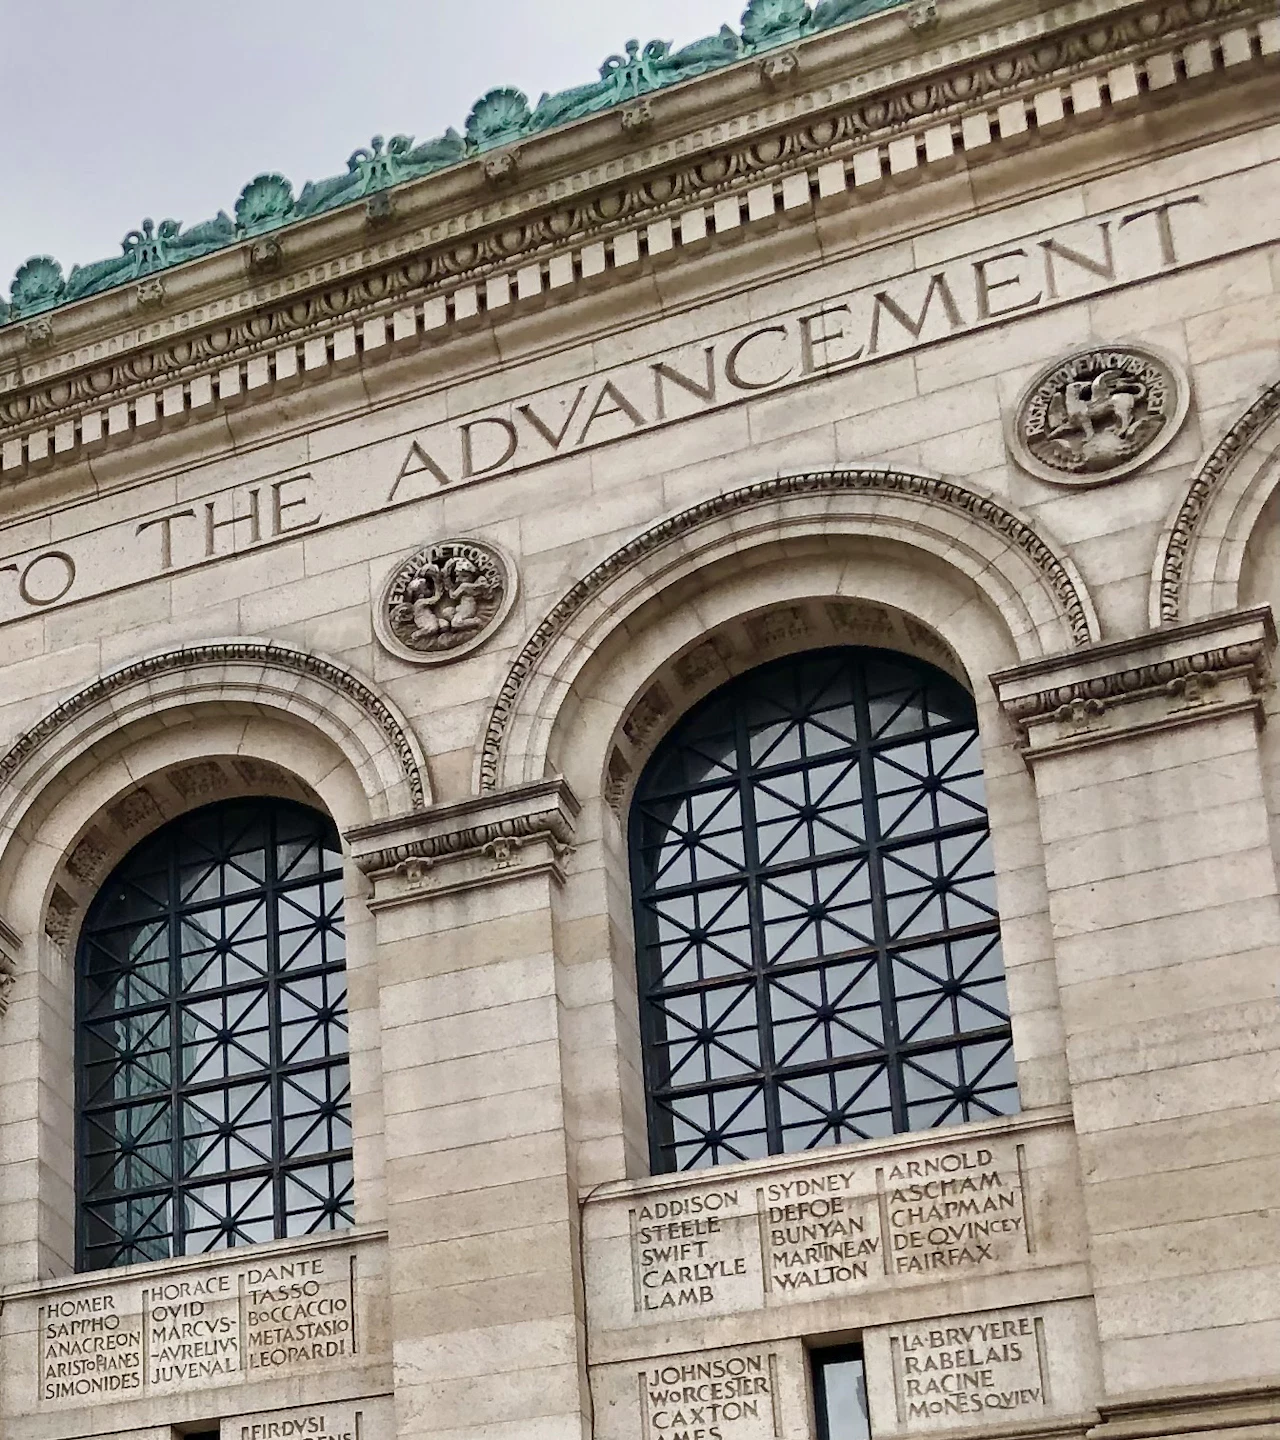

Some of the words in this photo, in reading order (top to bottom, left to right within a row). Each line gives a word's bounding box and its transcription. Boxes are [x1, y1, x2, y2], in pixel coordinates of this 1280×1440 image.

[136, 473, 324, 569] THE
[387, 195, 1207, 501] ADVANCEMENT
[889, 1149, 992, 1181] ARNOLD
[769, 1171, 855, 1202] SYDNEY
[890, 1171, 1003, 1205] ASCHAM
[640, 1190, 738, 1221] ADDISON
[769, 1196, 844, 1224] DEFOE
[892, 1192, 1015, 1228] CHAPMAN
[641, 1216, 721, 1244] STEELE
[771, 1216, 864, 1246] BUNYAN
[642, 1241, 709, 1266] SWIFT
[773, 1237, 880, 1270] MARTINEAV
[897, 1244, 992, 1274] FAIRFAX
[248, 1259, 324, 1285] DANTE
[643, 1259, 746, 1289] CARLYLE
[773, 1261, 868, 1291] WALTON
[151, 1276, 230, 1301] HORACE
[249, 1280, 320, 1306] TASSO
[645, 1286, 714, 1311] LAMB
[47, 1295, 115, 1318] HOMER
[152, 1301, 205, 1322] OVID
[248, 1299, 347, 1326] BOCCACCIO
[47, 1314, 120, 1339] SAPPHO
[249, 1320, 348, 1347] METASTASIO
[45, 1331, 140, 1359] ANACREON
[249, 1339, 345, 1369] LEOPARDI
[905, 1342, 1023, 1374] RABELAIS
[151, 1357, 236, 1384] JUVENAL
[649, 1355, 762, 1387] JOHNSON
[905, 1369, 994, 1398] RACINE
[45, 1372, 140, 1399] SIMONIDES
[649, 1376, 769, 1406] WORCESTER
[652, 1400, 759, 1430] CAXTON
